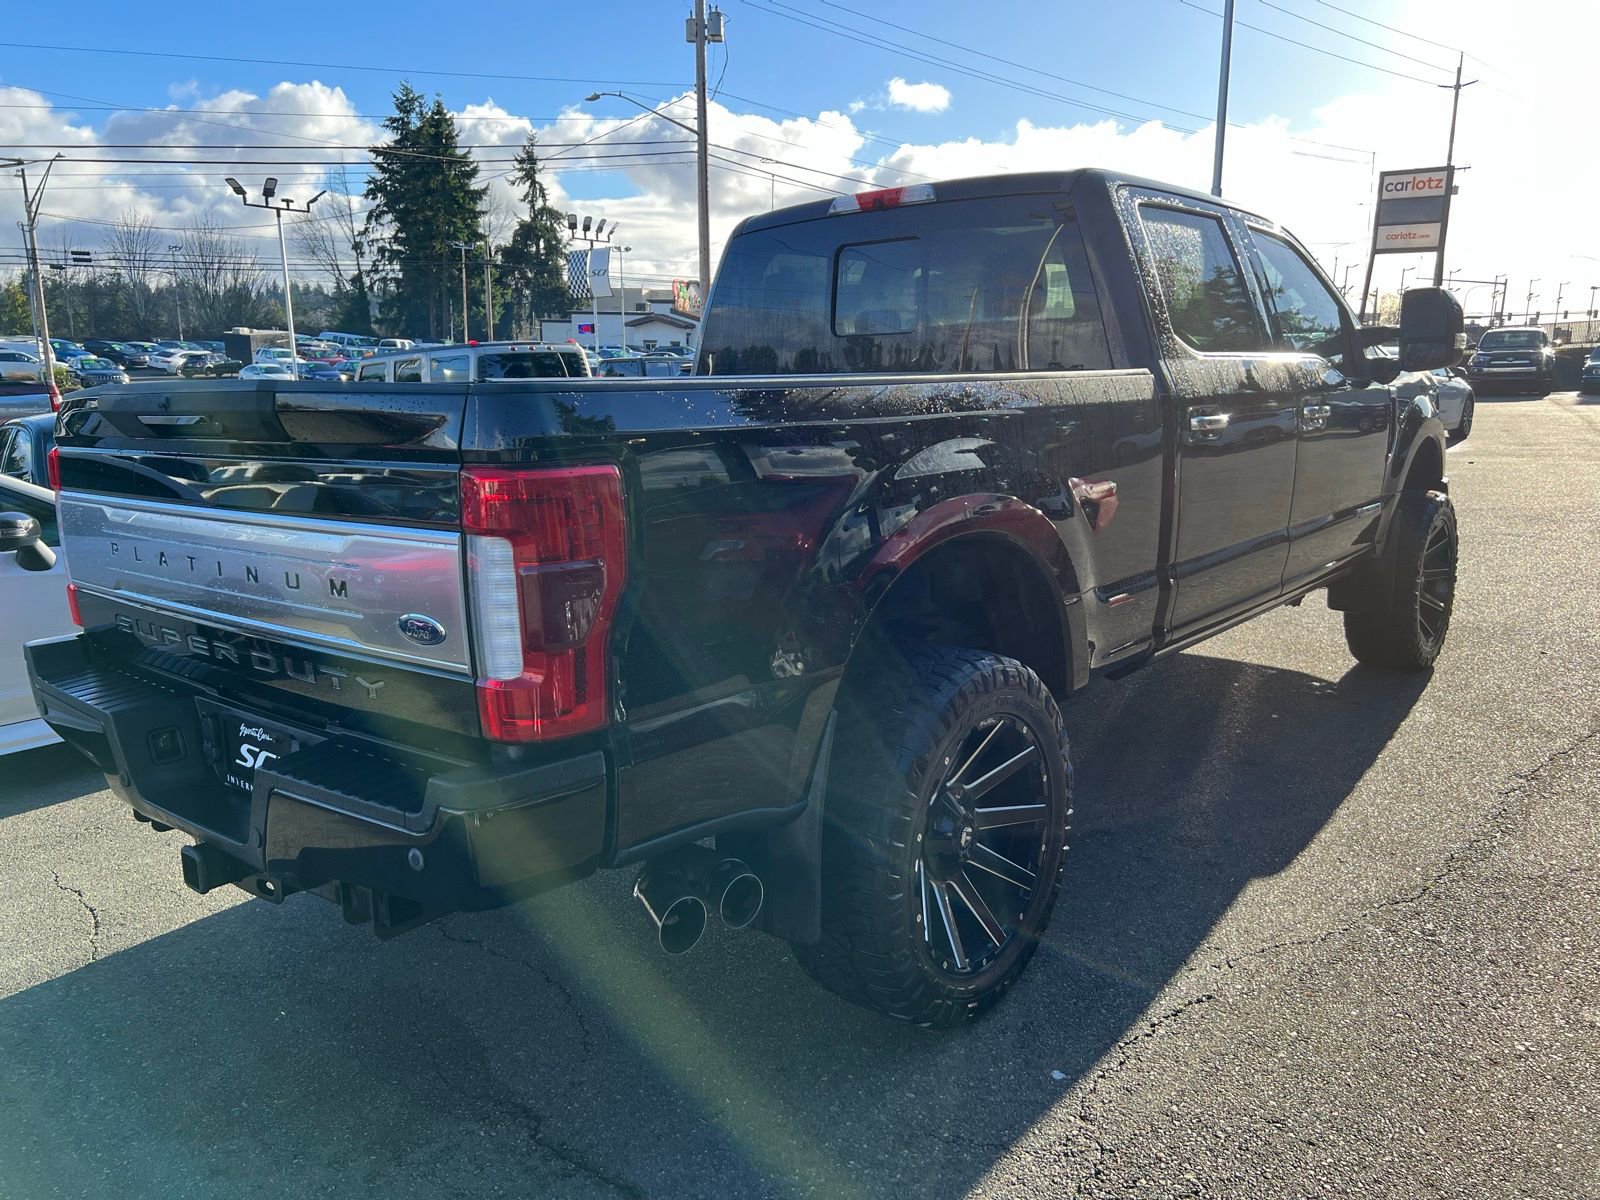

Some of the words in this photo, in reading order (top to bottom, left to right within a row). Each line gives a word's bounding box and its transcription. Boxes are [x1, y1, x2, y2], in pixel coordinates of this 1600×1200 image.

[1385, 176, 1444, 192] carlotz
[1386, 232, 1430, 240] carlotz.com
[110, 542, 349, 599] PLATINUM
[405, 618, 434, 641] Ford
[114, 612, 240, 664] SUPER
[250, 652, 386, 699] DUTY
